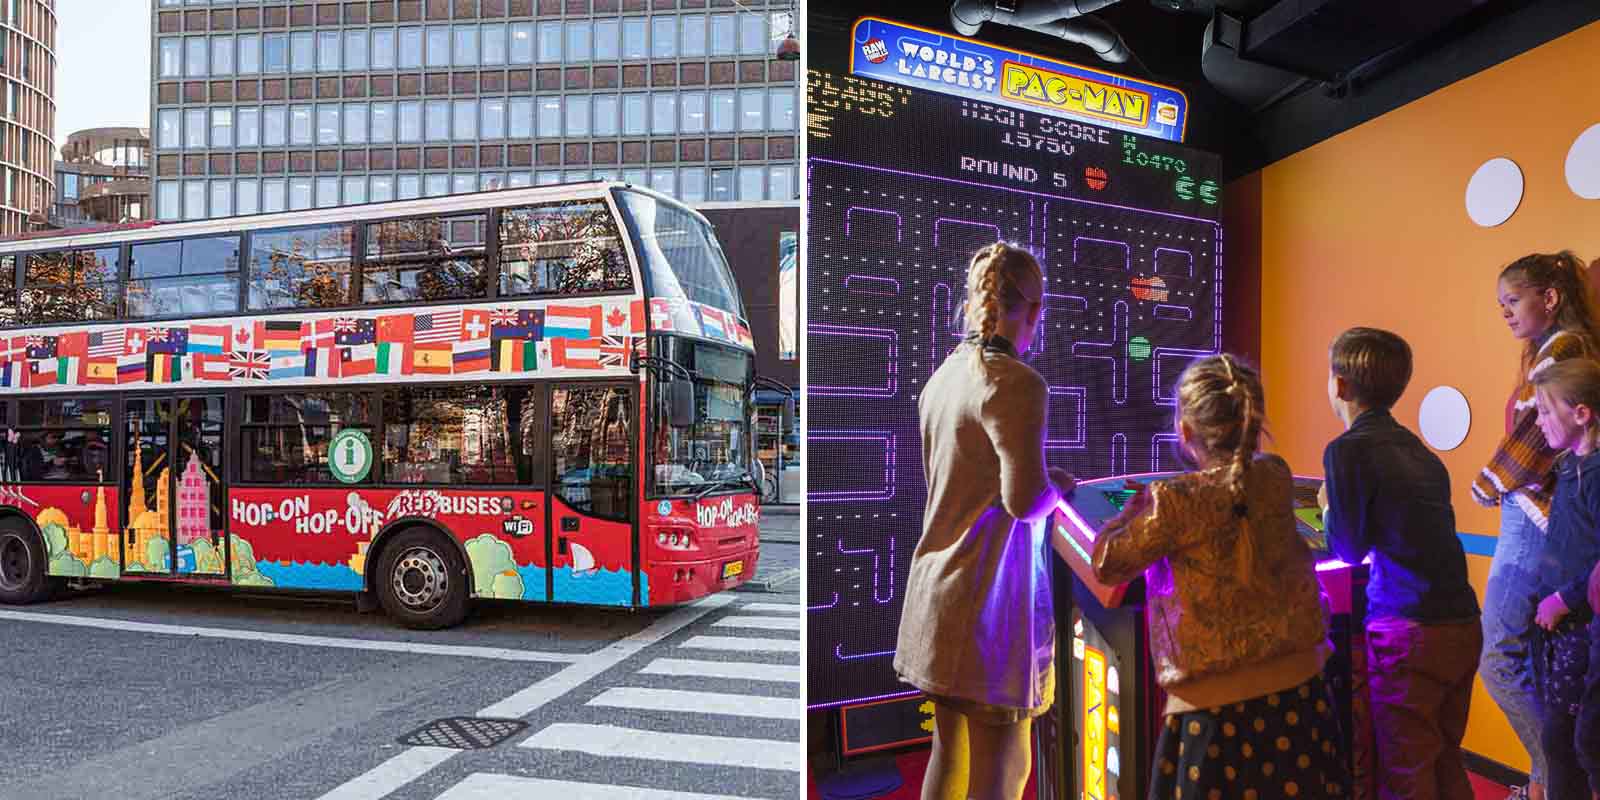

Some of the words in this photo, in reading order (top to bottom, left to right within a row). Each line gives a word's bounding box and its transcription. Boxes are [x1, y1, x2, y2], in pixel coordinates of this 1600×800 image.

[902, 41, 995, 76] WORLD'S
[898, 58, 997, 93] LARGEST
[1008, 67, 1145, 121] PAC-MAN
[1001, 132, 1075, 156] 15750
[1040, 118, 1110, 145] SCORE
[1053, 172, 1068, 188] 5
[232, 495, 310, 526] HOP-ON
[296, 505, 384, 534] HOP-OFF
[440, 496, 501, 515] BUSES
[696, 496, 733, 528] HOP-ON
